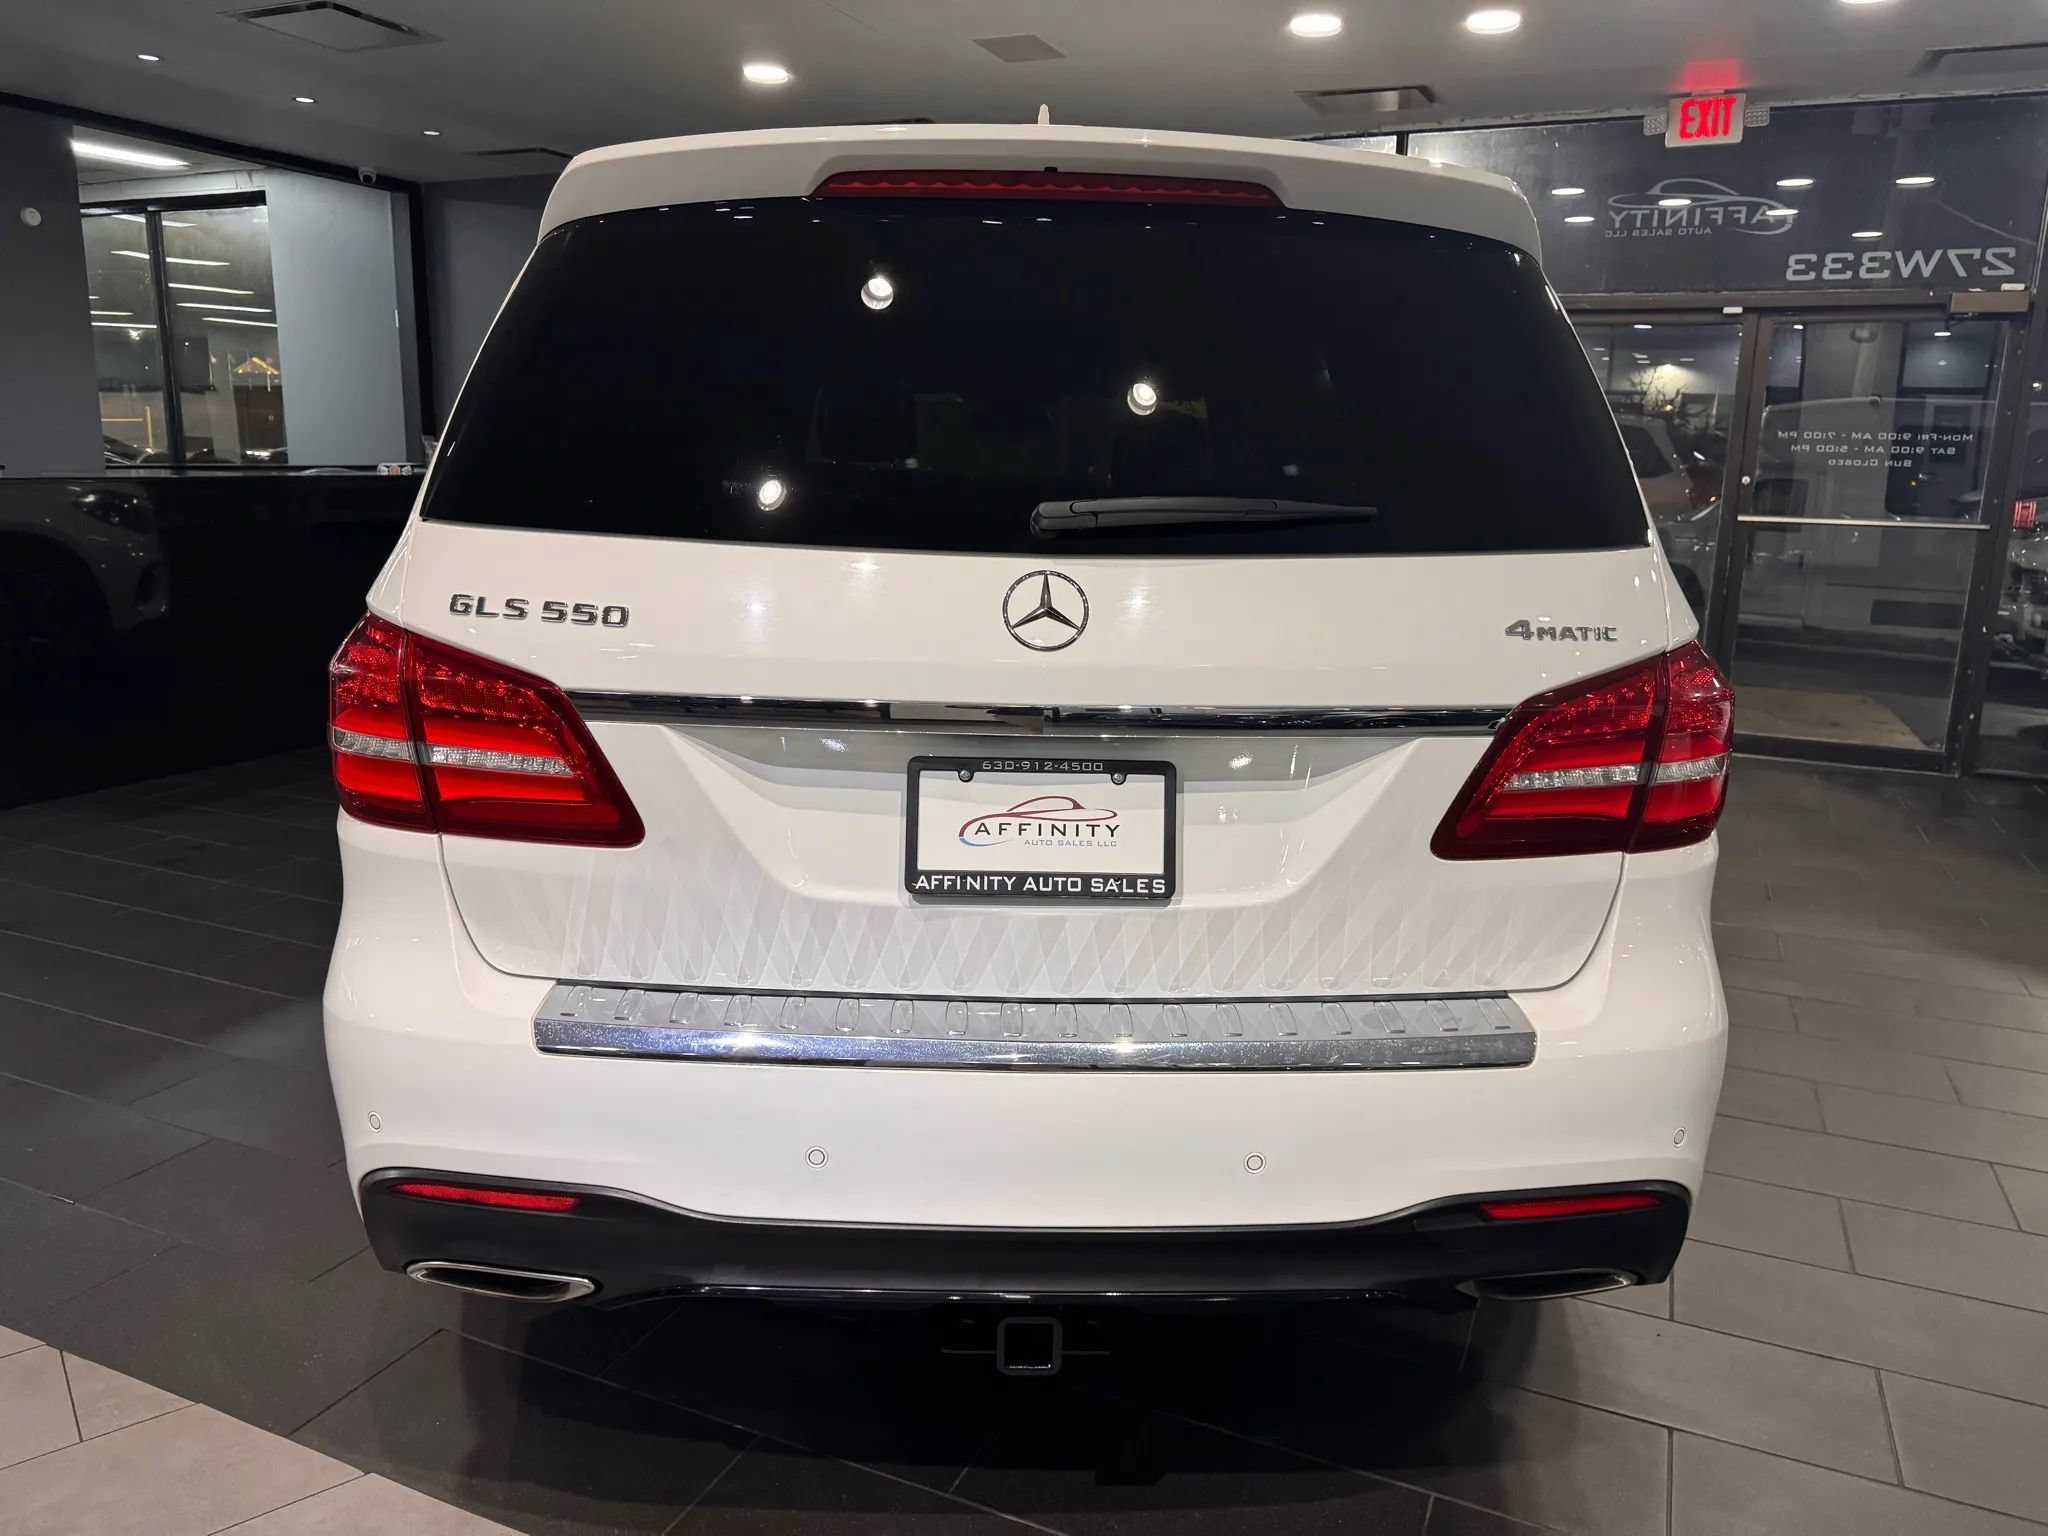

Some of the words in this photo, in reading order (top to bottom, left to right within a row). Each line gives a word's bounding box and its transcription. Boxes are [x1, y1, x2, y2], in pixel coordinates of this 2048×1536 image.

[1679, 95, 1738, 139] EXIT
[449, 593, 530, 620] GLS
[540, 600, 630, 628] 550
[1505, 619, 1618, 641] 4MATIC
[982, 760, 1104, 772] 630-912-4500
[974, 822, 1121, 838] AFFINITY
[1024, 839, 1053, 847] AUTO
[1057, 839, 1093, 847] SALES
[1097, 840, 1117, 848] LLC
[915, 875, 1016, 891] AFFINITY
[1023, 876, 1082, 892] AUTO
[1091, 878, 1166, 894] SALES
